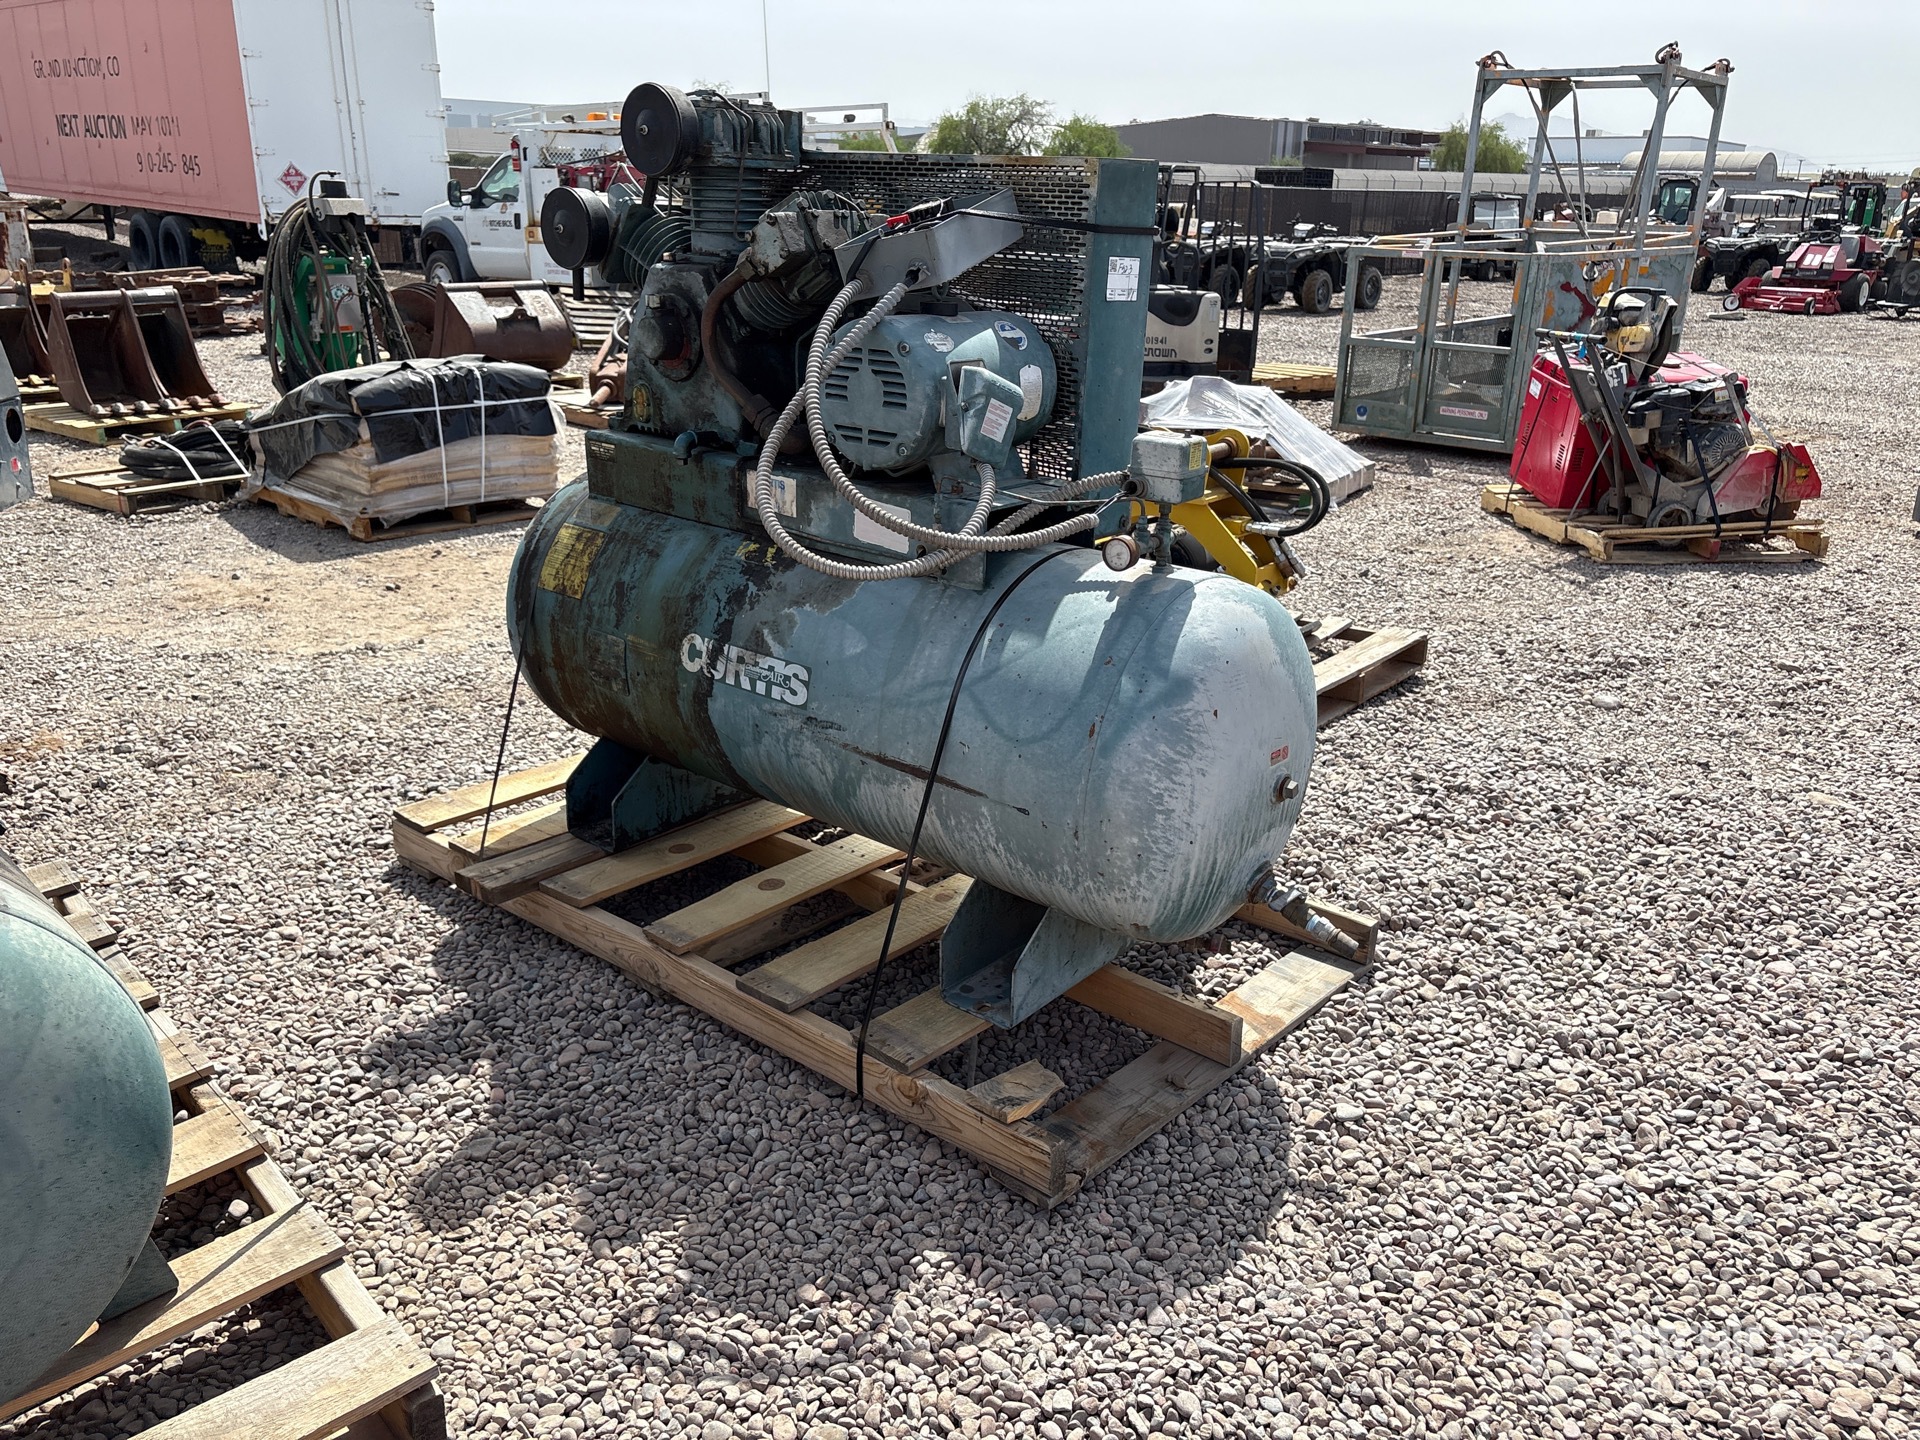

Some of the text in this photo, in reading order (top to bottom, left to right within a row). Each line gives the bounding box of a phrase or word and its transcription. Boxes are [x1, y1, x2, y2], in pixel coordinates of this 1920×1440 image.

[33, 59, 61, 78] GRND
[106, 56, 120, 77] CO
[55, 114, 80, 138] NEXT
[83, 114, 128, 139] AUCTION
[130, 116, 153, 136] MAY
[681, 633, 808, 706] CURTIS
